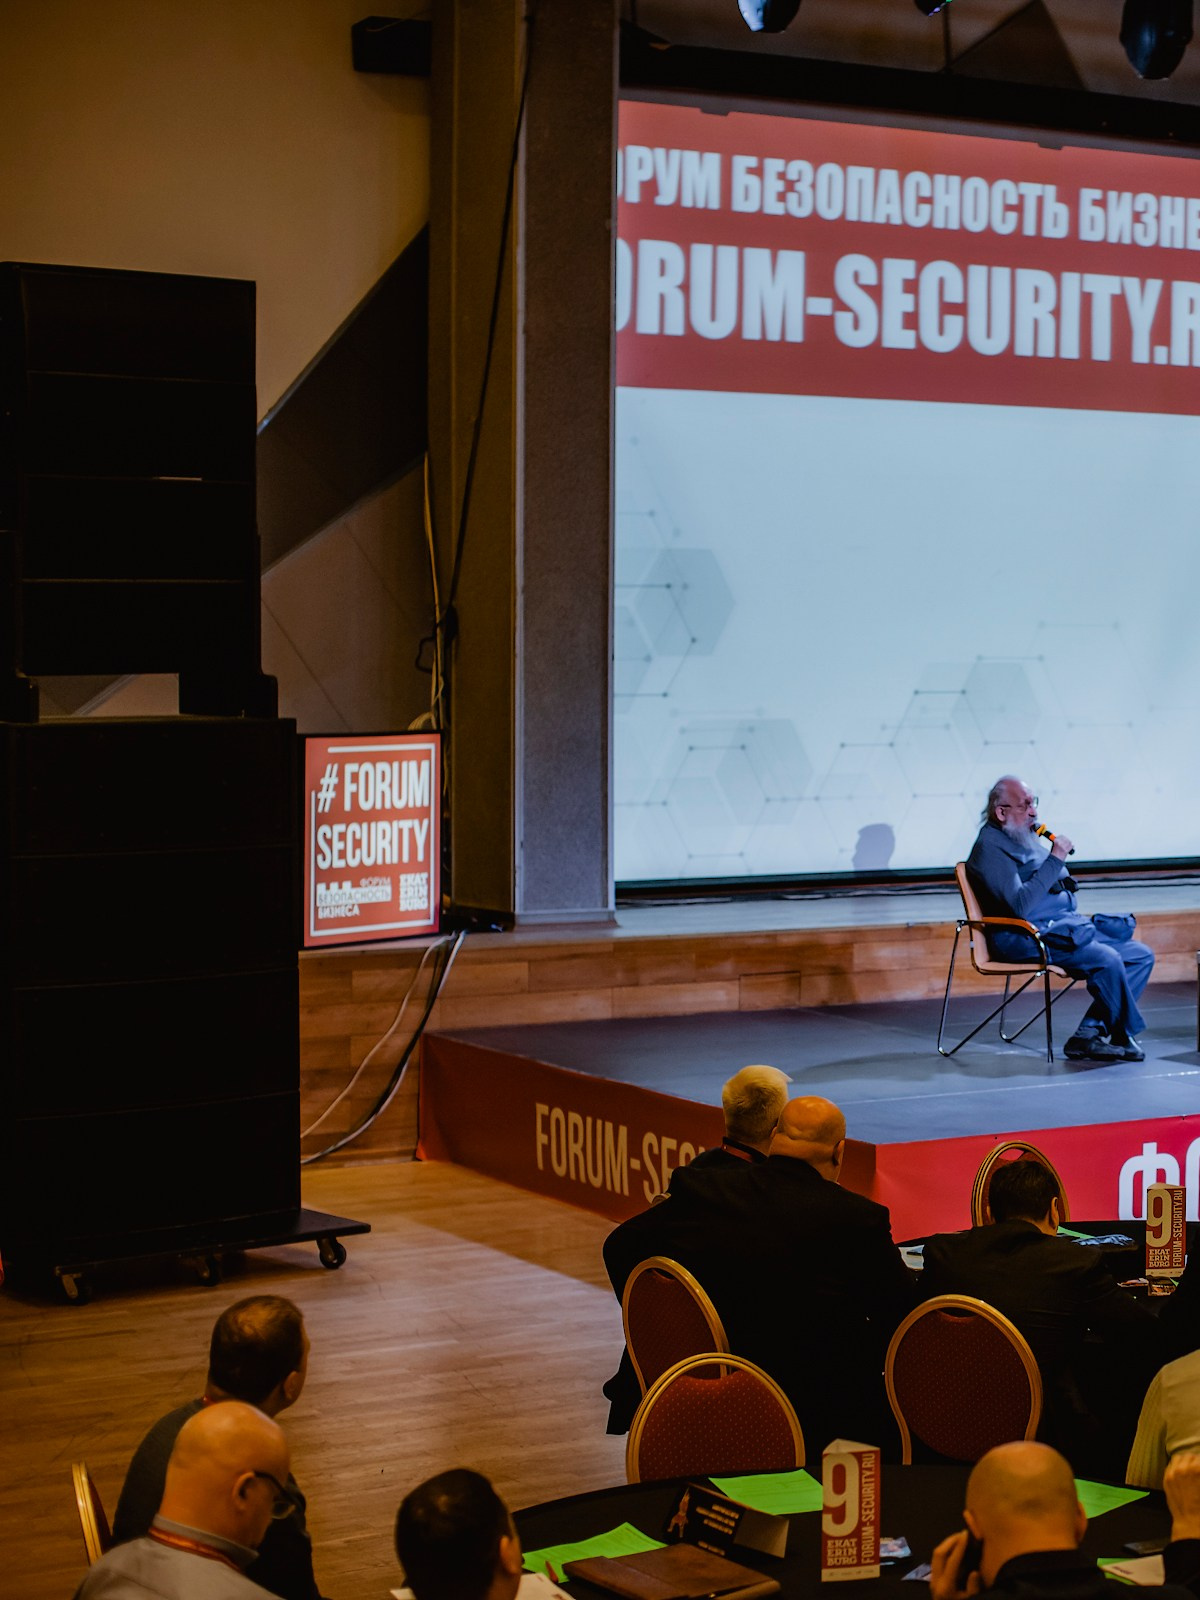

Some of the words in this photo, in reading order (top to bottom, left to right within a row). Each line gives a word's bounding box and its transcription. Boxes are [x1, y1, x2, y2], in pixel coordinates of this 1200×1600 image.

[731, 154, 1069, 239] БЕЗОПАСНОСТЬ
[316, 818, 429, 870] SECURITY
[536, 1103, 705, 1205] FORUM-SE
[1146, 1189, 1172, 1248] 9
[1173, 1190, 1183, 1267] FORUM-SECURITY.RU
[822, 1453, 859, 1537] 9
[861, 1453, 875, 1563] FORUM-SECURITY.RU
[827, 1539, 857, 1548] EKAT
[827, 1548, 857, 1557] ERIN
